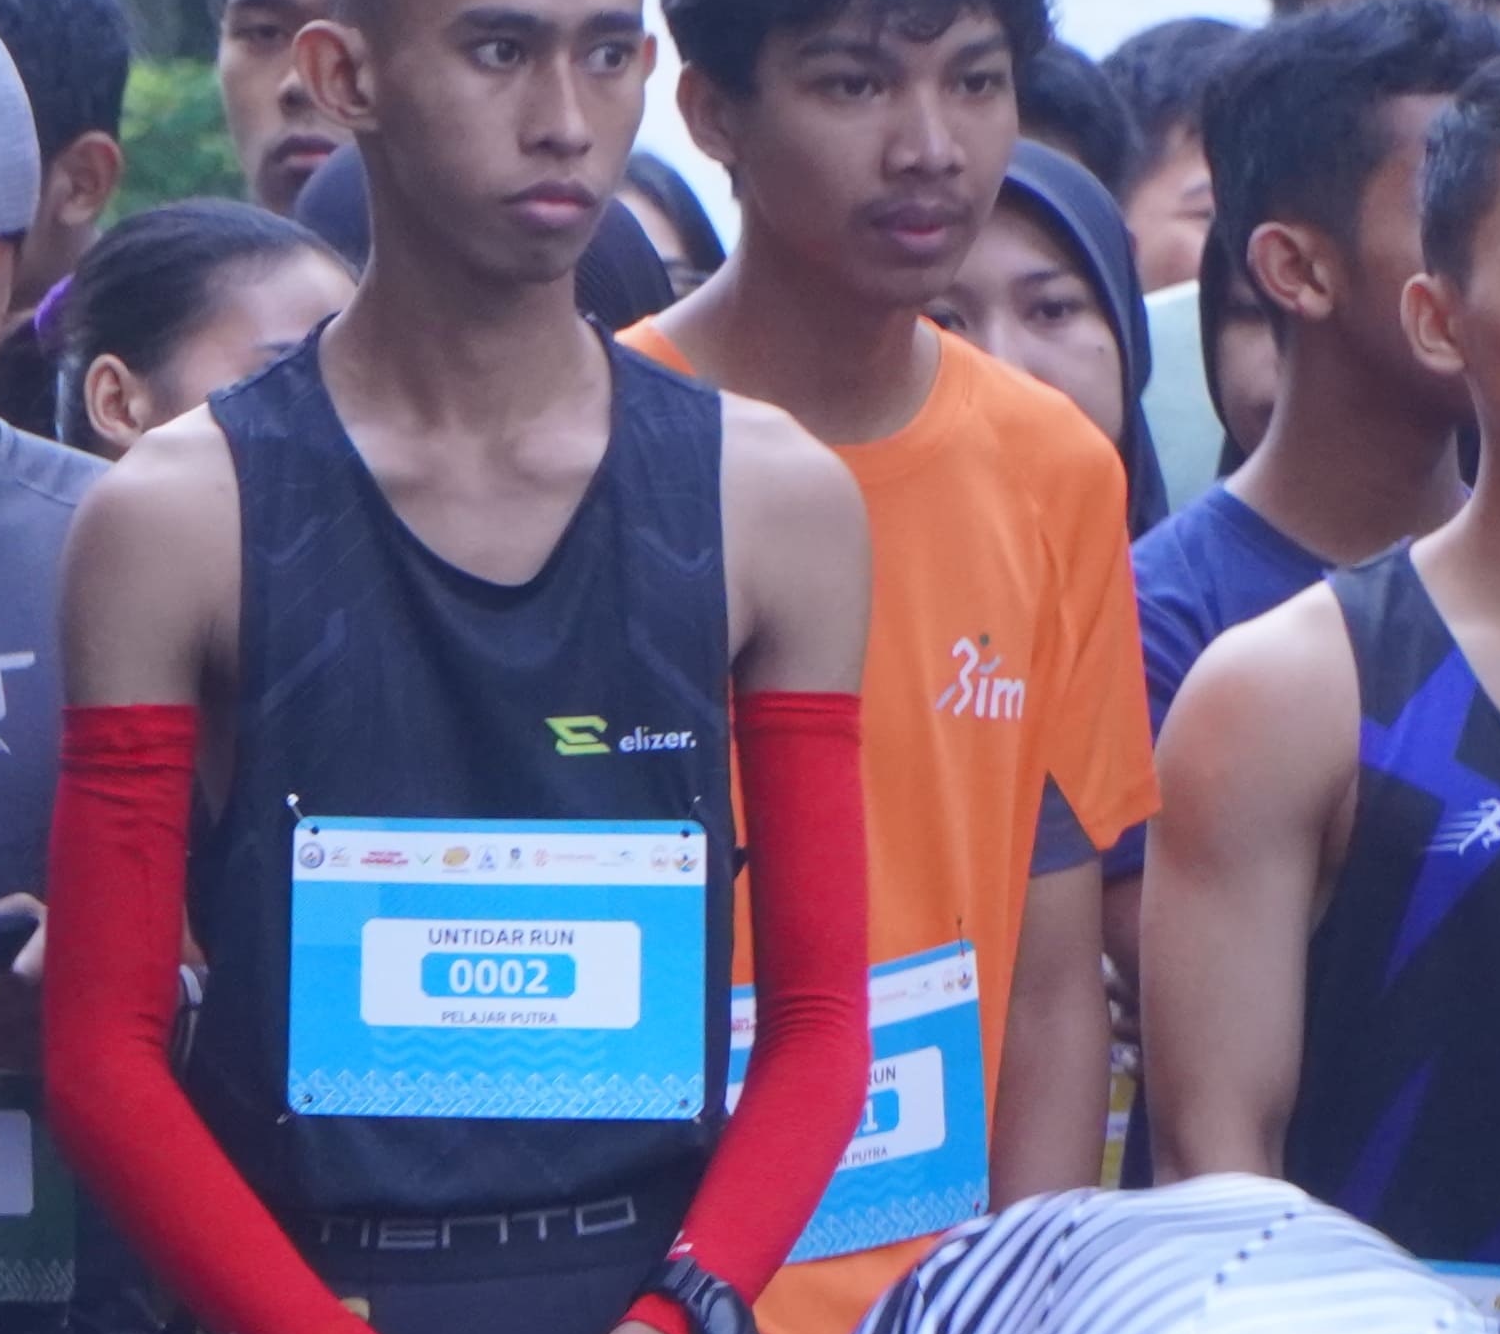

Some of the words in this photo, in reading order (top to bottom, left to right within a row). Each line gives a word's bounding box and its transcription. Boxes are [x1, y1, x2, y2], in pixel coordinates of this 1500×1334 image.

[428, 927, 524, 946] UNTIDAR
[530, 929, 575, 946] RUN
[450, 959, 549, 995] 0002
[441, 1011, 506, 1024] PELAJAR
[510, 1012, 558, 1024] PUTRA
[852, 1146, 888, 1163] PUTRA
